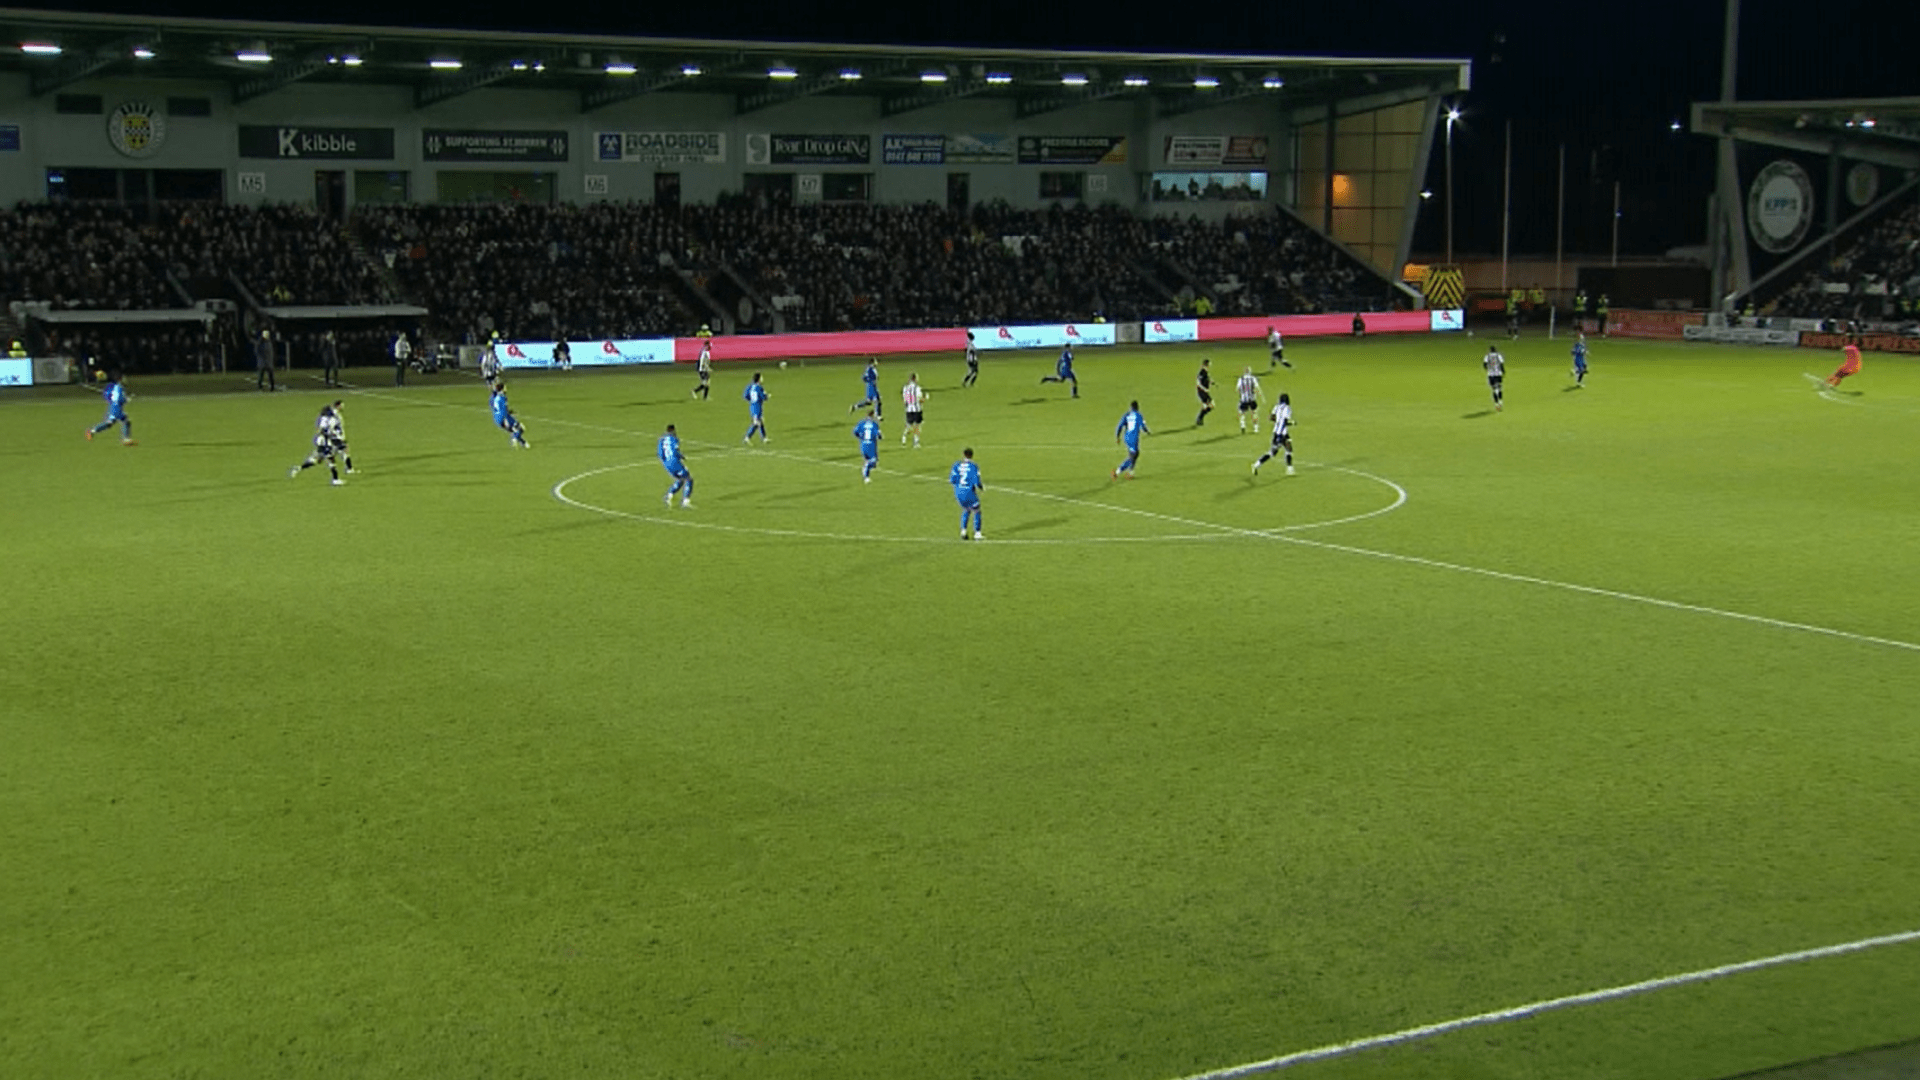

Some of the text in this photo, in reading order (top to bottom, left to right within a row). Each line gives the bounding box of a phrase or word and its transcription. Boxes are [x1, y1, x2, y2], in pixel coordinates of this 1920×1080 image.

[302, 134, 357, 151] kibble
[625, 133, 719, 149] ROADSIDE
[240, 178, 264, 192] M5
[959, 472, 969, 485] 2
